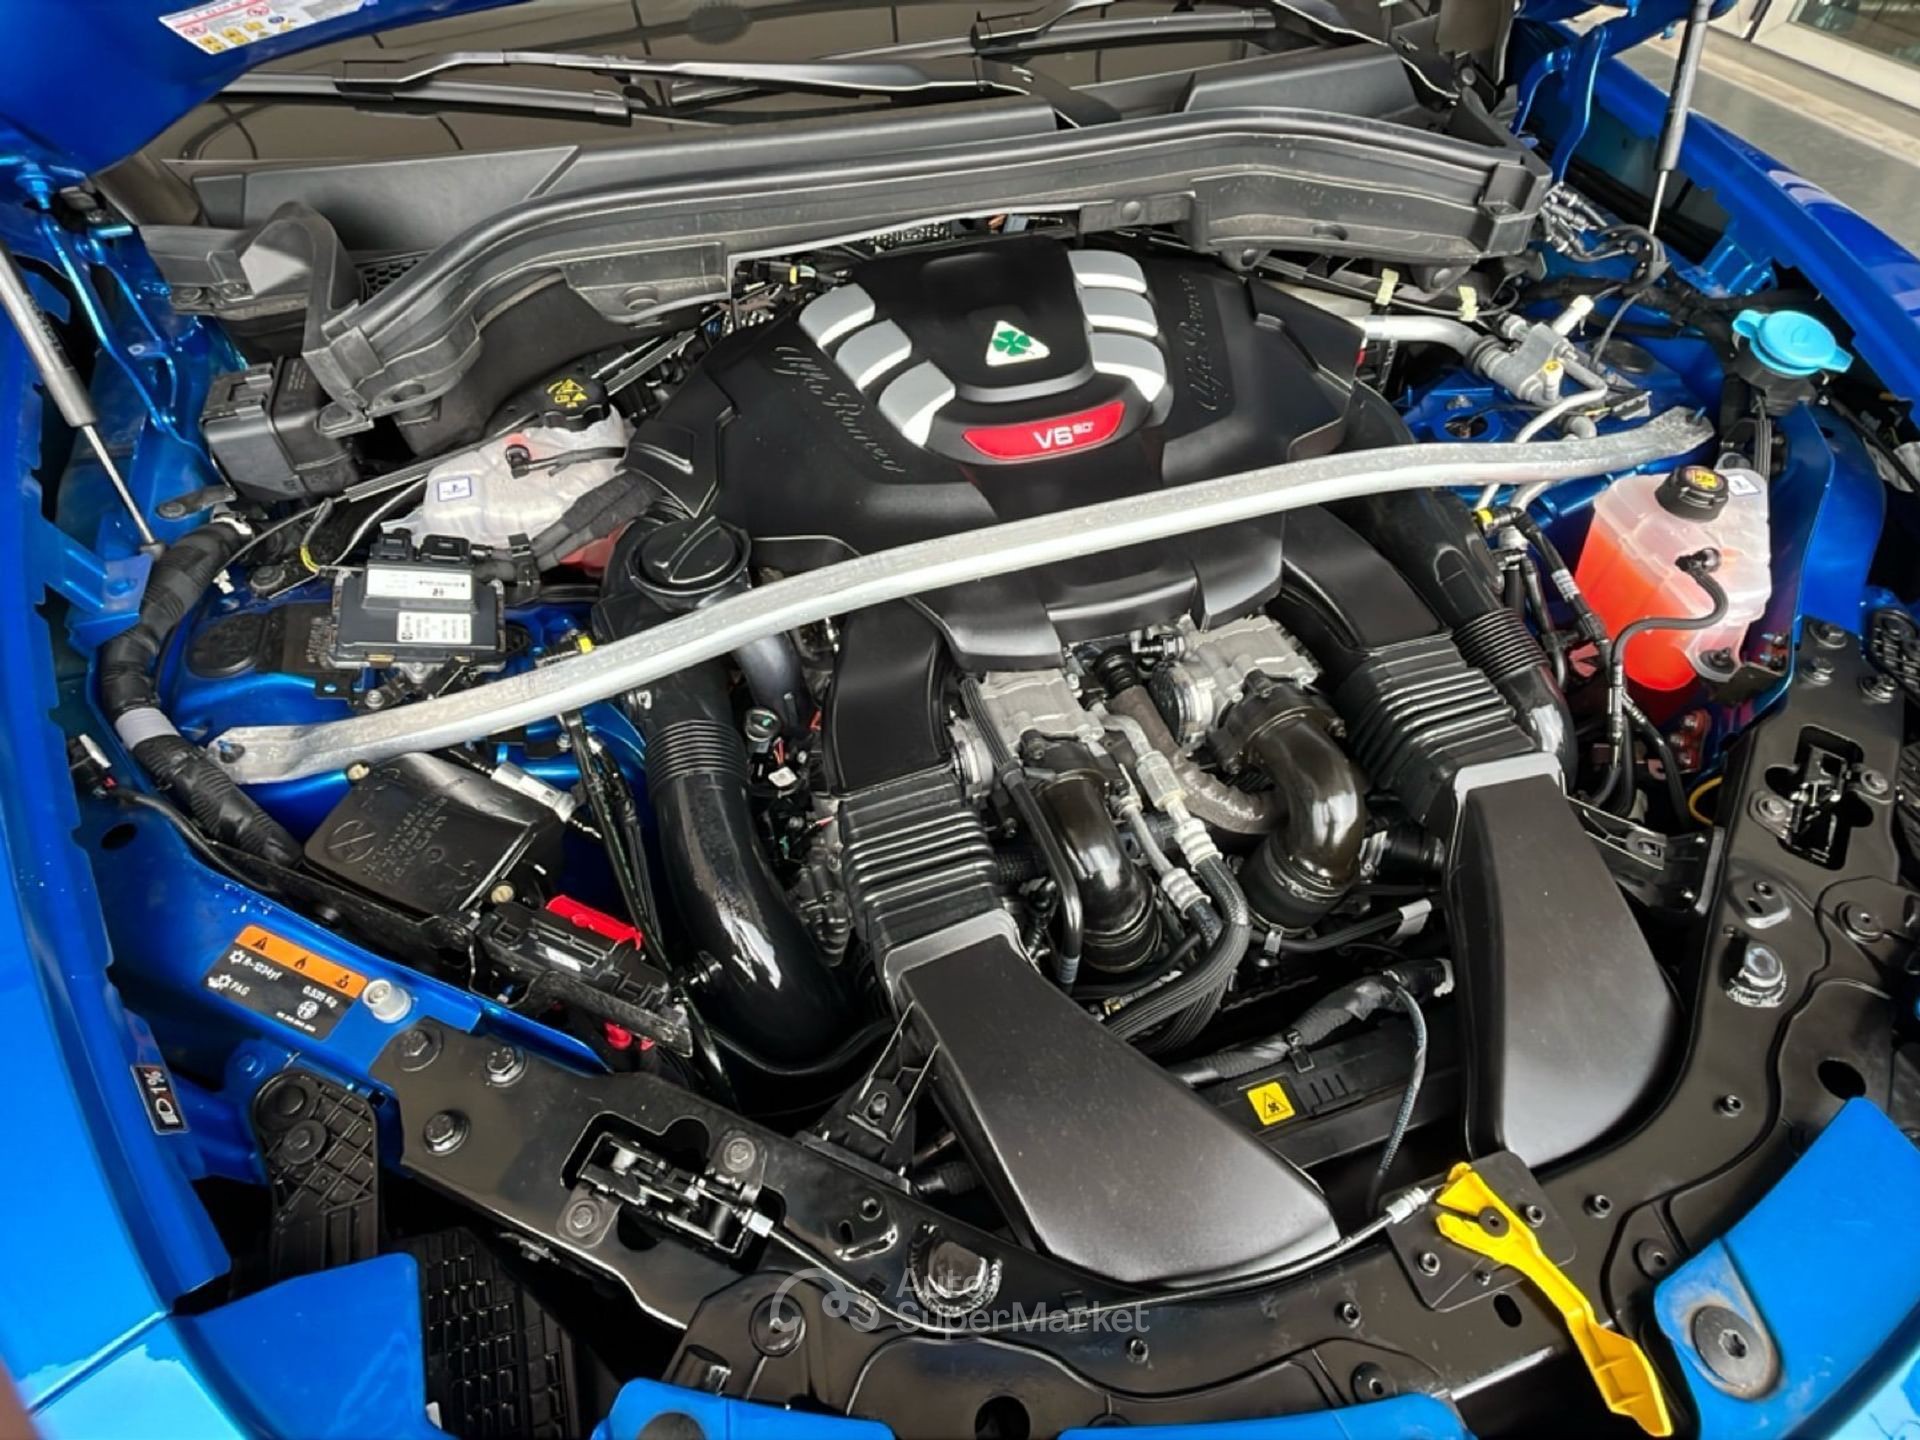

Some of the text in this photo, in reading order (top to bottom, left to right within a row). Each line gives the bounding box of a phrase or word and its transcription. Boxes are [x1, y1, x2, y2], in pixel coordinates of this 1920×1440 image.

[772, 346, 906, 473] Alfa Romeo
[1032, 426, 1074, 450] V6
